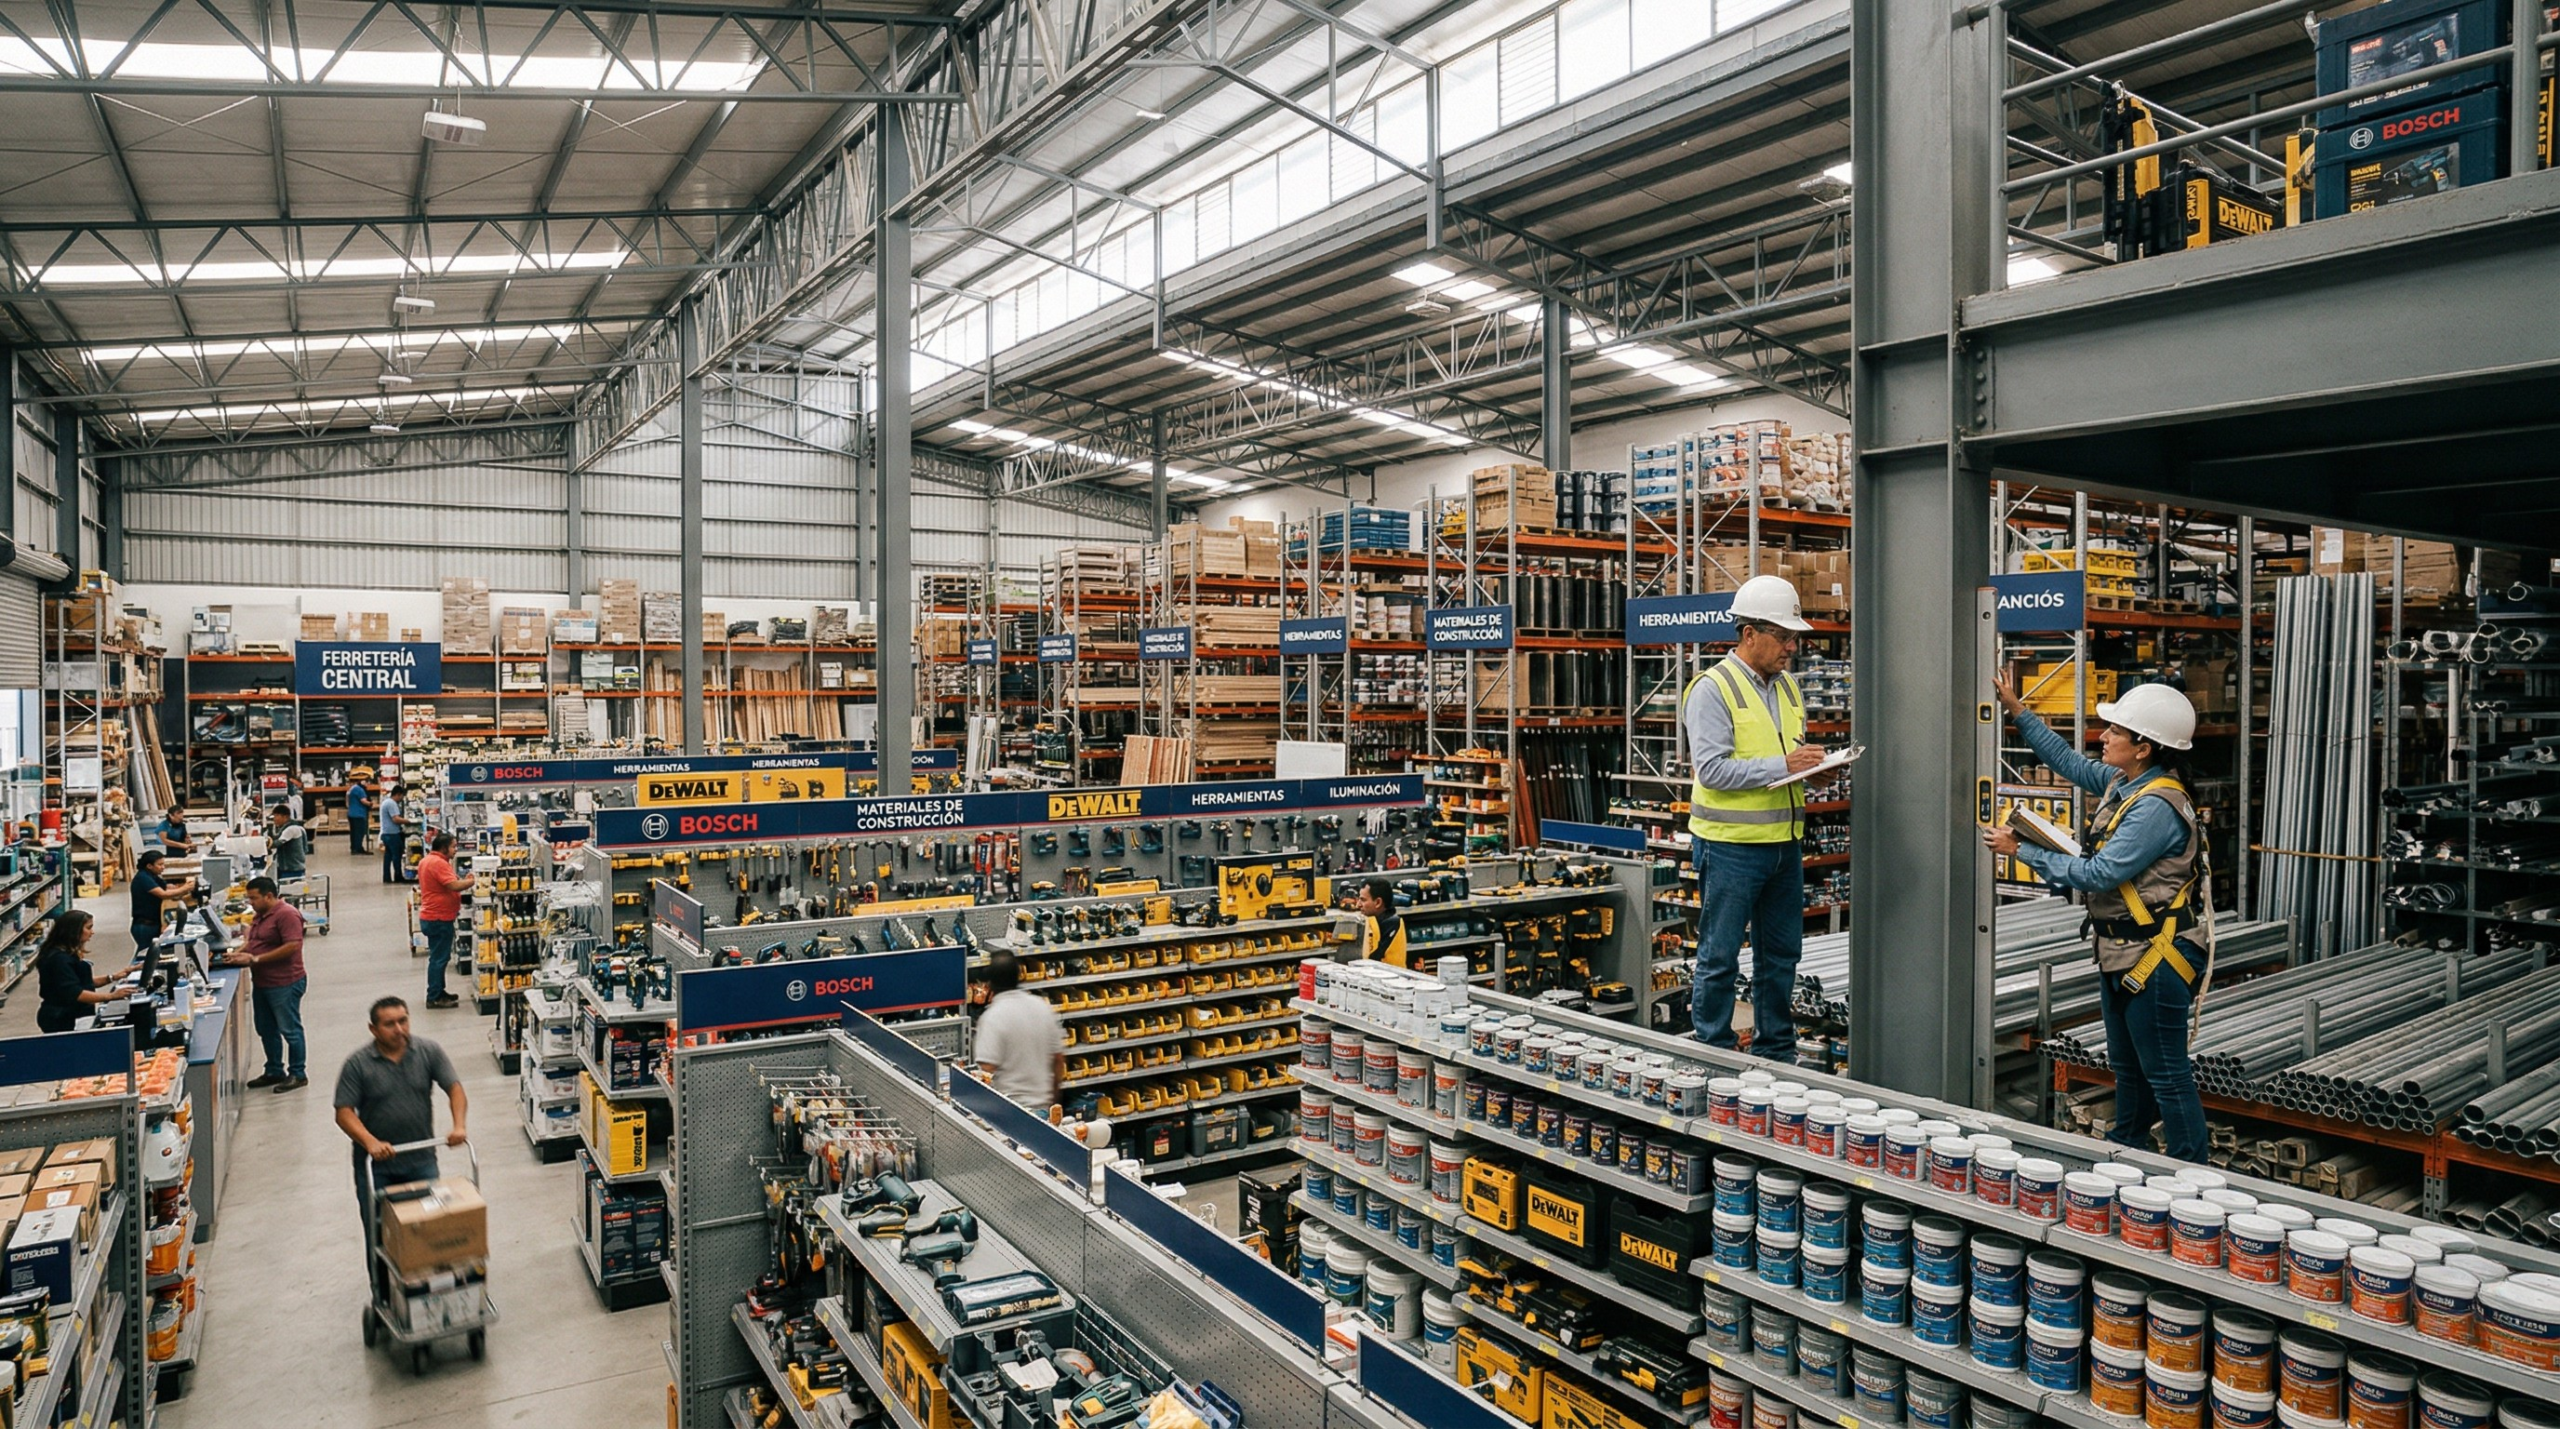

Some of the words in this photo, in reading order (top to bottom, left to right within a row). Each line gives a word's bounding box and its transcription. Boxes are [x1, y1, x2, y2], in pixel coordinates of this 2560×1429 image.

[2382, 107, 2460, 140] BOSCH
[1488, 613, 1503, 626] DE
[1639, 607, 1733, 627] HERRAMIENTAS
[322, 647, 416, 667] FERRETERÍA
[321, 668, 417, 689] CENTRAL
[494, 767, 543, 779] BOSCH
[650, 781, 728, 799] DEWALT
[1191, 789, 1286, 806] HERRAMIENTAS
[1329, 781, 1401, 799] ILUMINACIÓN
[857, 801, 942, 816] MATERIALES
[944, 799, 963, 812] DE
[1049, 793, 1141, 818] DEWALT
[680, 813, 758, 835] BOSCH
[857, 811, 965, 830] CONSTRUCCIÓN
[814, 976, 874, 996] BOSCH
[1532, 1194, 1579, 1227] DEWALT
[1620, 1233, 1679, 1271] DEWALT
